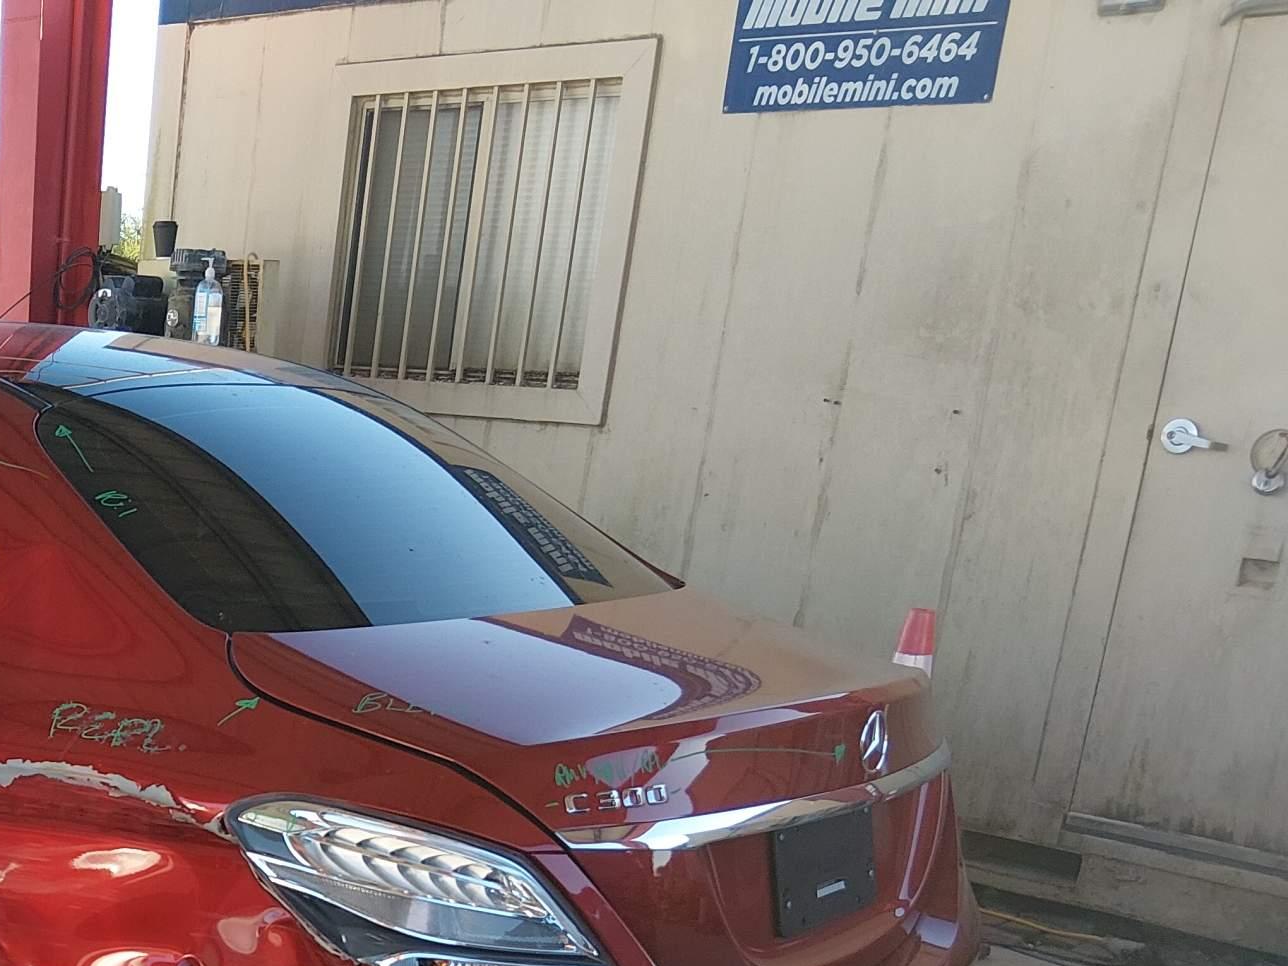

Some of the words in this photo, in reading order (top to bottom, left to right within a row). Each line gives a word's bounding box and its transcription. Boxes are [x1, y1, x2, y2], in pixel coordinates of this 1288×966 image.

[746, 30, 982, 73] 1-800-950-6464
[752, 73, 959, 106] mobilemini.com
[564, 793, 590, 814] C
[596, 784, 669, 810] 300
